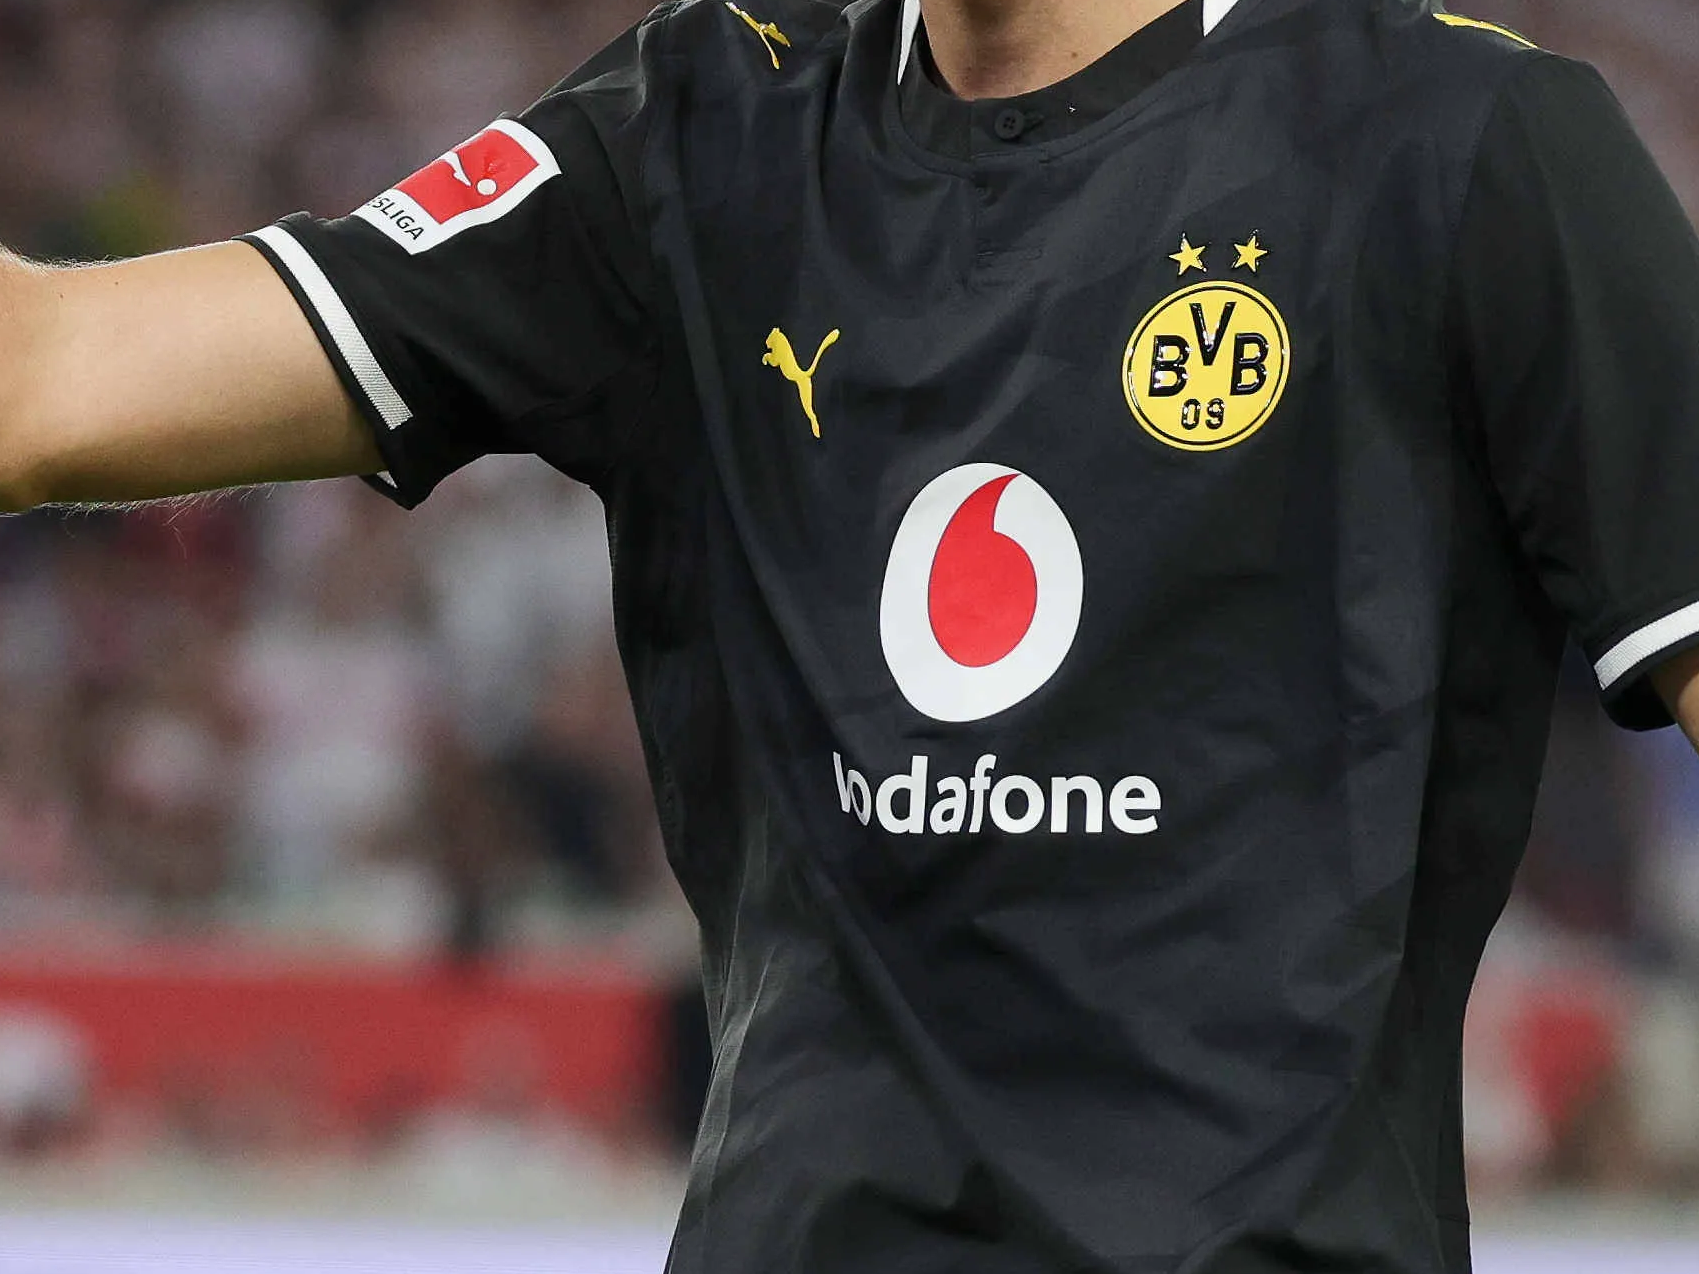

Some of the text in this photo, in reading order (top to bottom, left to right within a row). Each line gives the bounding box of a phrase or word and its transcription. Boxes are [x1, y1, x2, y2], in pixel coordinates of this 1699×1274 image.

[367, 196, 424, 240] SLIGA
[1148, 301, 1269, 397] BVB
[1181, 398, 1225, 430] 09
